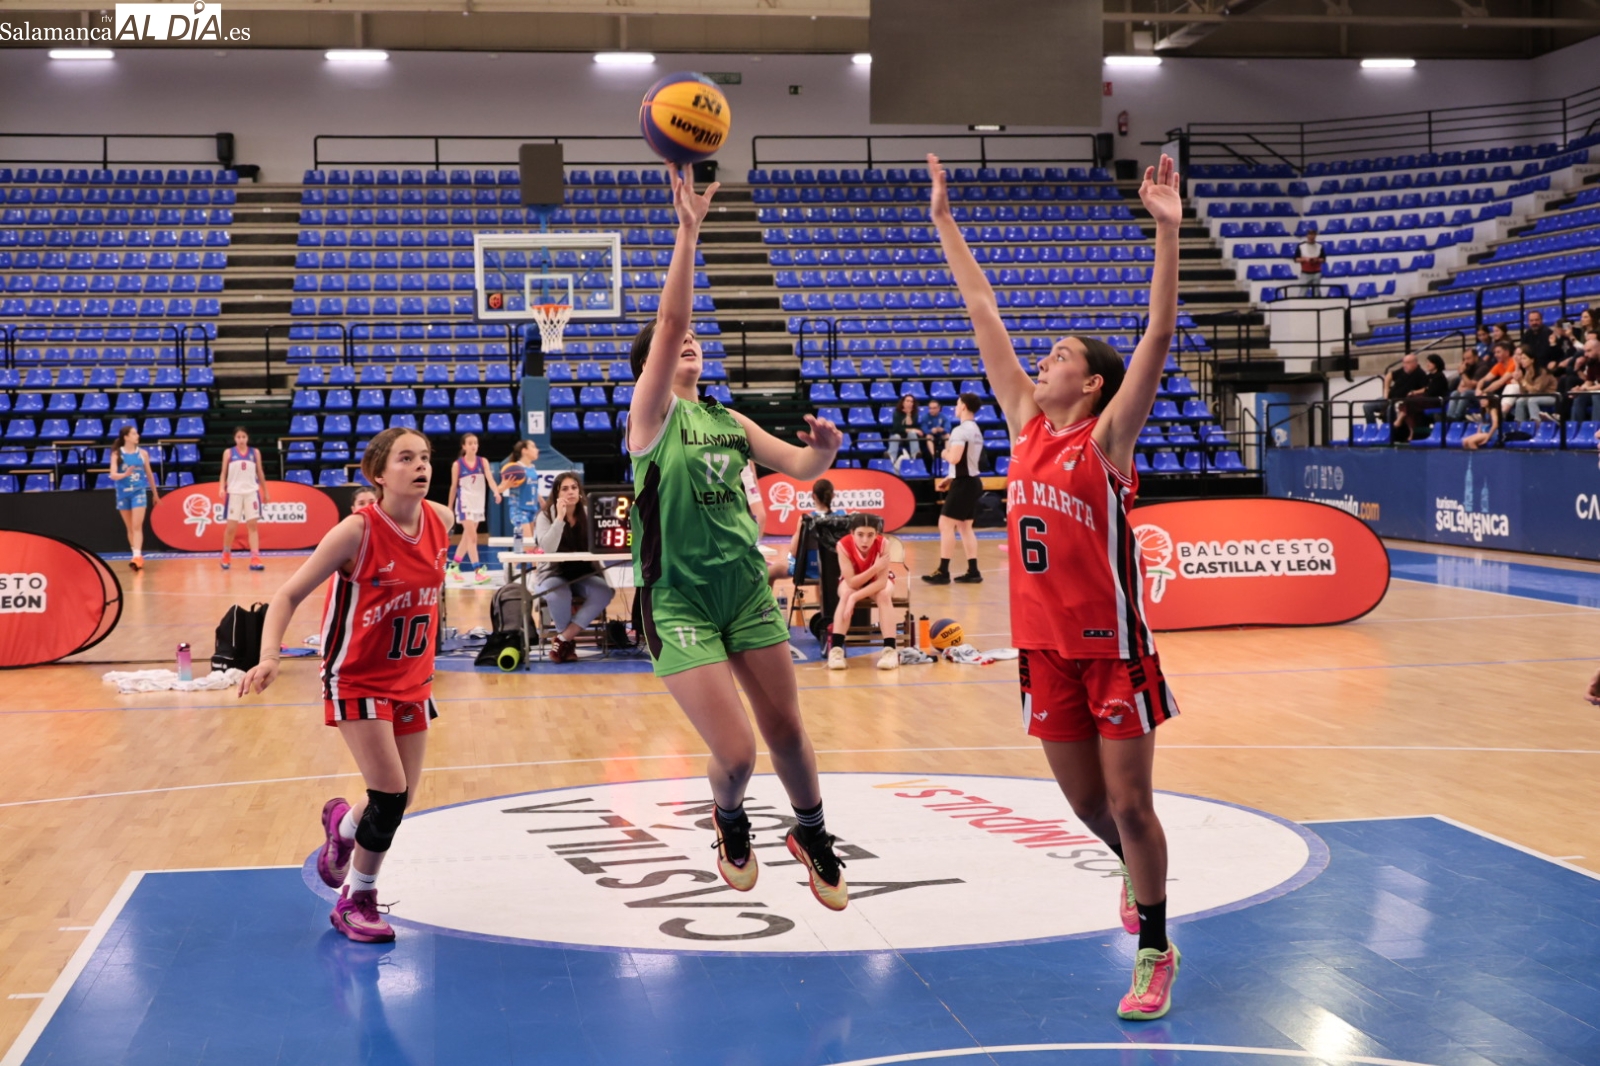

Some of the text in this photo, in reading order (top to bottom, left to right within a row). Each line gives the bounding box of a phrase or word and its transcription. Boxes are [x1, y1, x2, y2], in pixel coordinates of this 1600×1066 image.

[670, 114, 723, 147] Wilson
[703, 452, 730, 485] 17
[277, 512, 304, 521] LEÓN
[1032, 480, 1096, 531] MARTA
[598, 519, 621, 528] LOCAL
[606, 528, 625, 547] 13
[1018, 515, 1049, 574] 6
[1181, 542, 1330, 557] BALONCESTO
[1183, 556, 1332, 575] CASTILLA Y LEÓN
[362, 591, 411, 628] SANTA
[386, 613, 431, 660] 10
[674, 626, 697, 649] 17
[940, 625, 961, 639] Wilson
